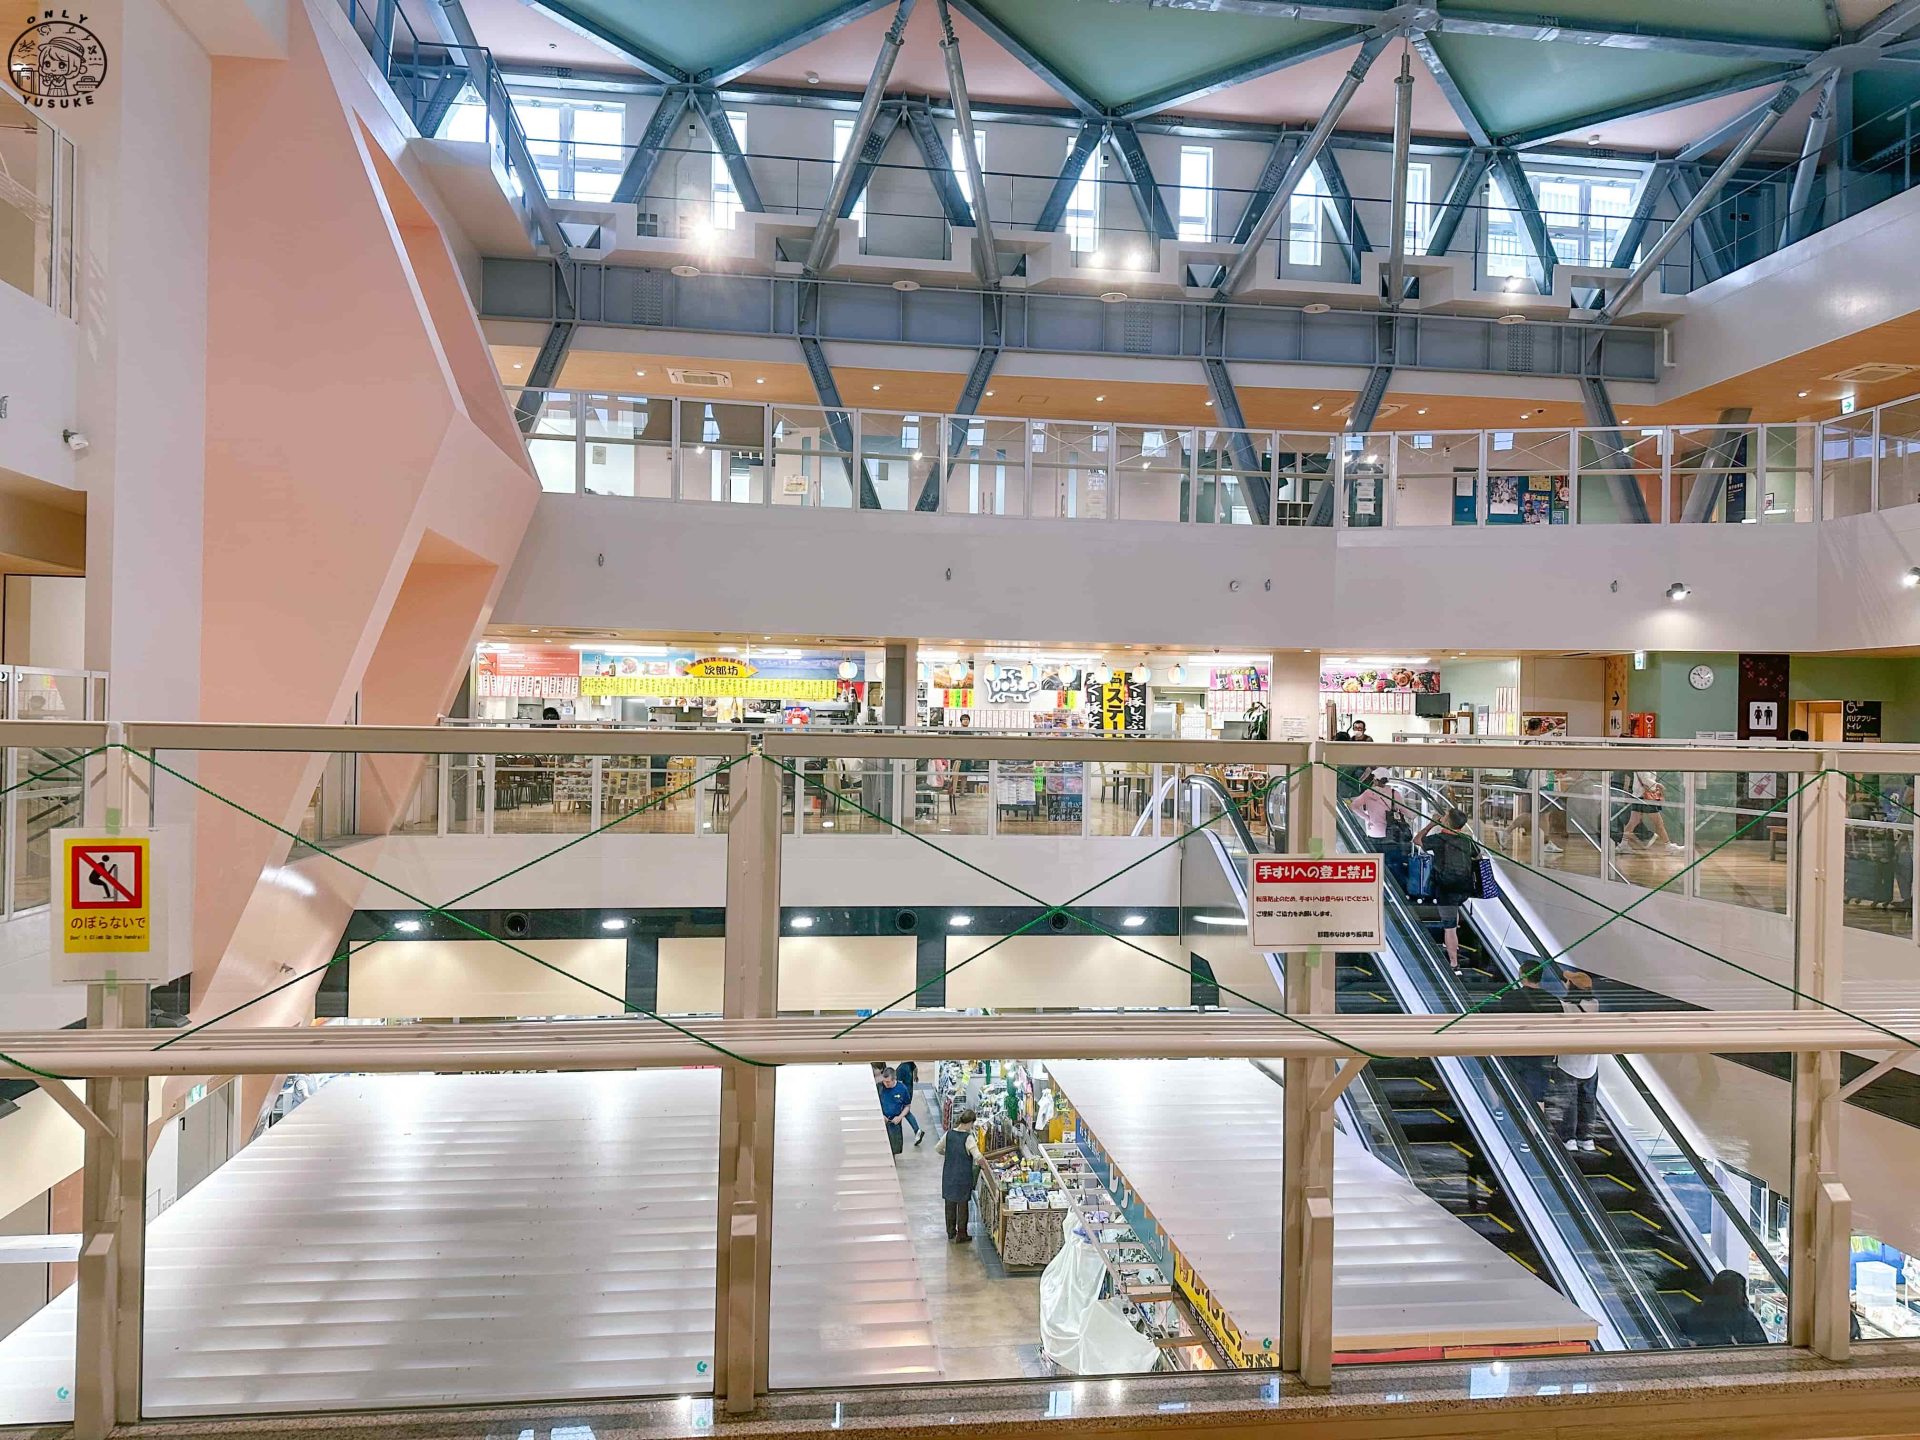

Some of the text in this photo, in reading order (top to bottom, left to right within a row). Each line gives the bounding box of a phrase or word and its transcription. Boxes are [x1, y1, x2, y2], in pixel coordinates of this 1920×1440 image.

[704, 665, 739, 676] 次郎坊
[1258, 865, 1374, 880] 手すりへの登上禁止
[71, 916, 146, 930] のぼらないで
